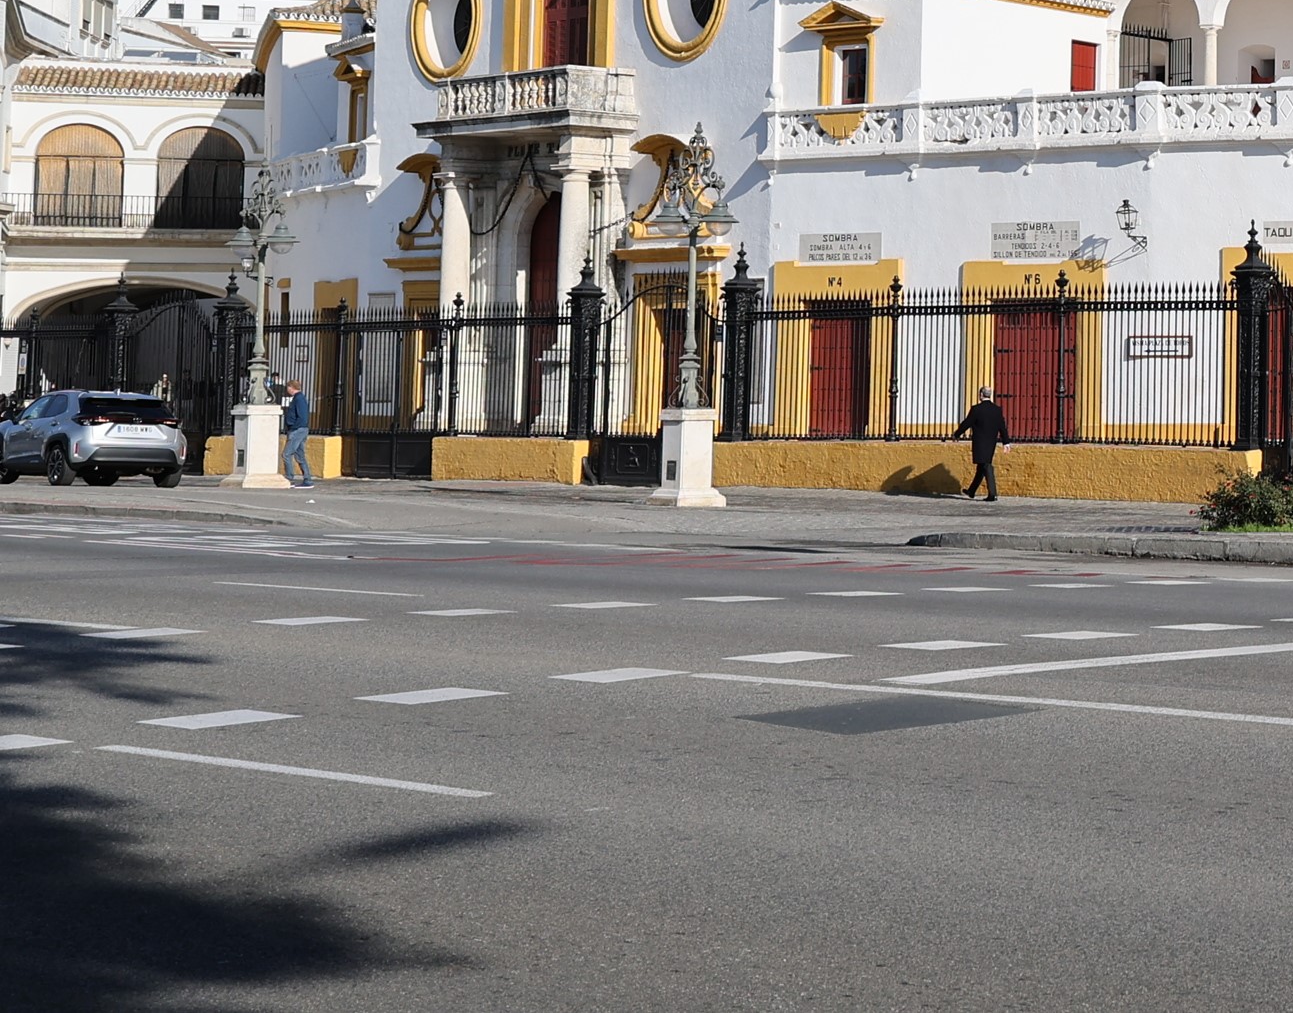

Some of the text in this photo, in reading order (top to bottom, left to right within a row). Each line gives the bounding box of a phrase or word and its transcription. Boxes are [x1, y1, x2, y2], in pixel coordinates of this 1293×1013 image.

[1016, 223, 1054, 231] SOMBRA
[822, 234, 858, 242] SOMBRA
[1011, 242, 1037, 250] TENDIDOS
[809, 253, 825, 261] PALCOS
[826, 253, 840, 261] PARES
[1024, 250, 1047, 258] TENDIDO
[837, 276, 842, 287] 4
[1034, 273, 1041, 284] 6
